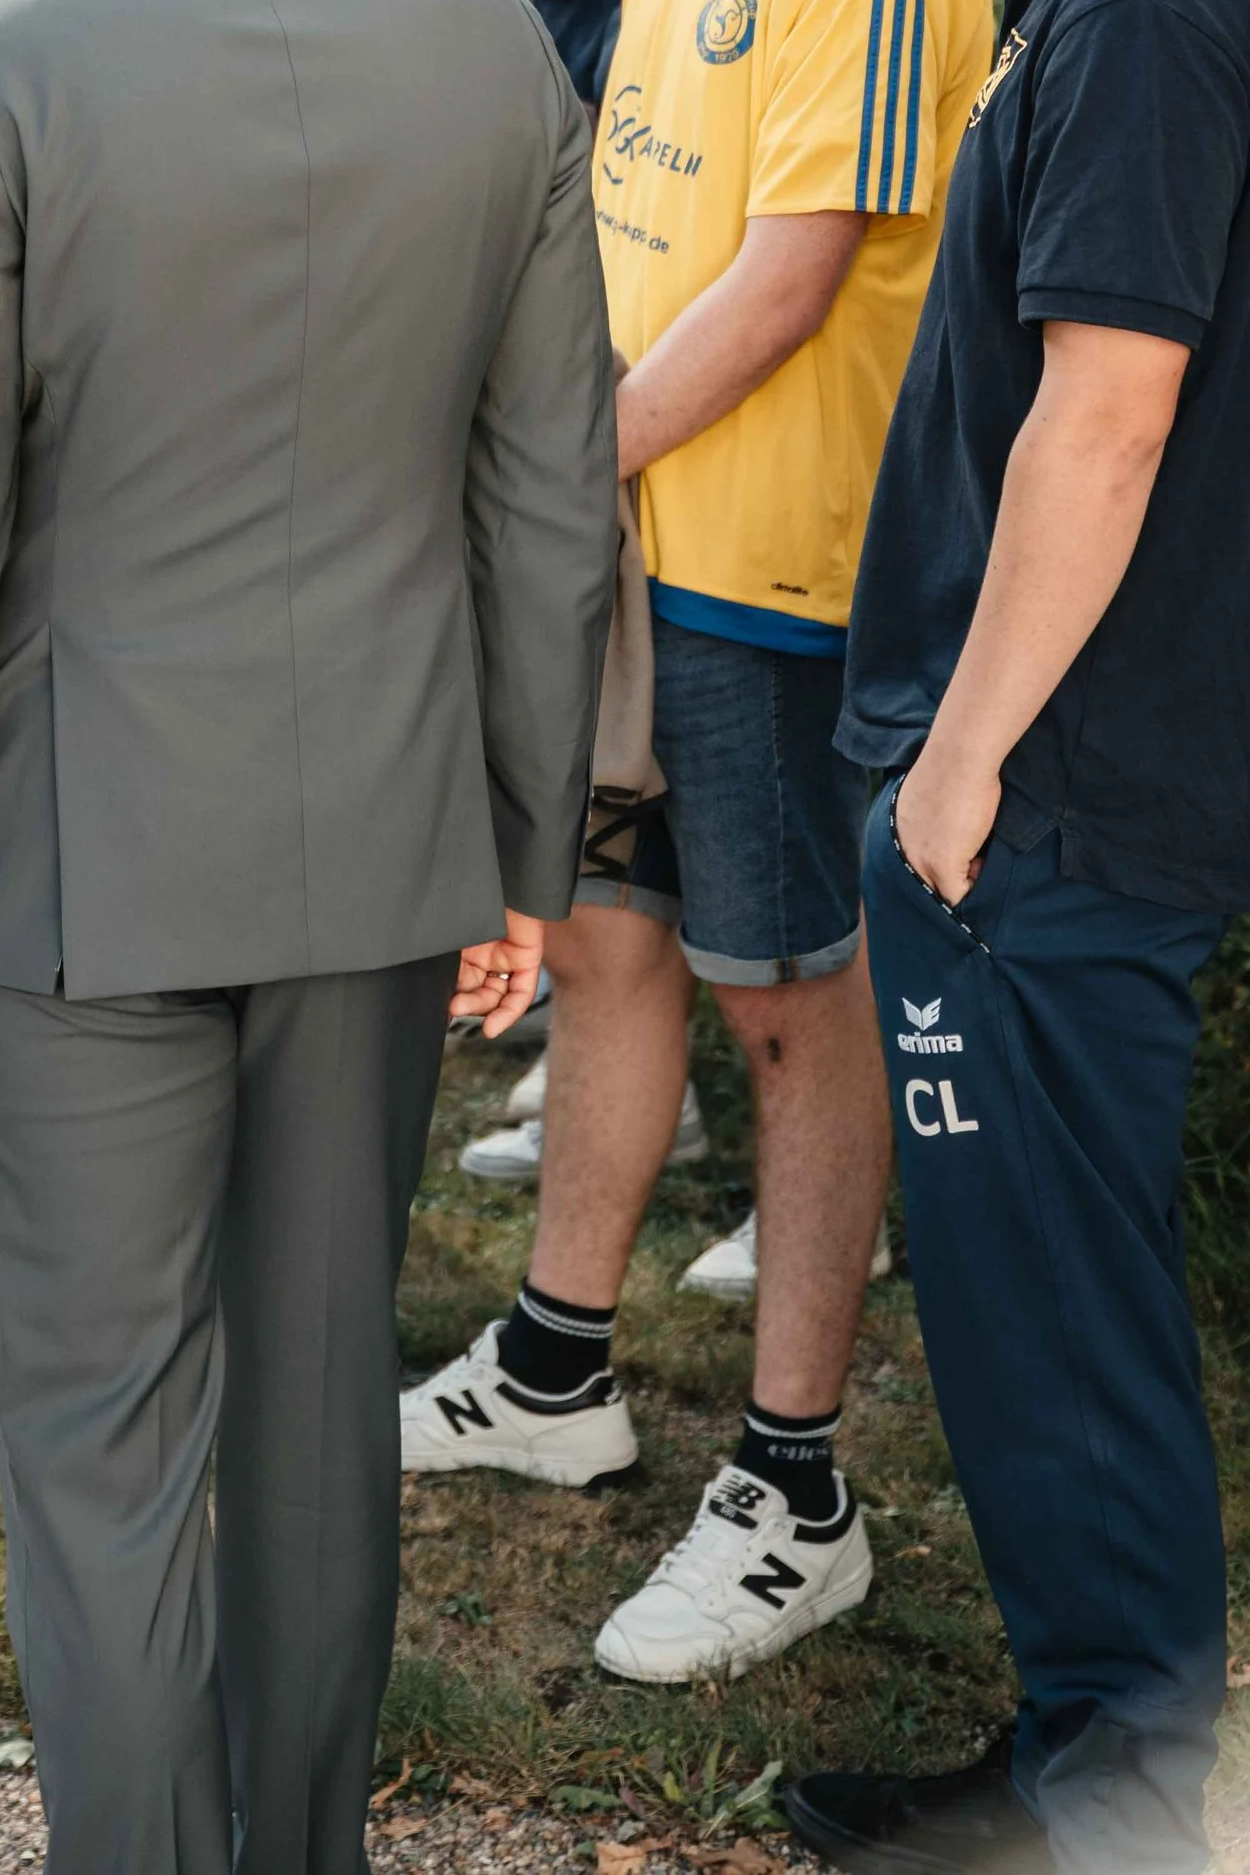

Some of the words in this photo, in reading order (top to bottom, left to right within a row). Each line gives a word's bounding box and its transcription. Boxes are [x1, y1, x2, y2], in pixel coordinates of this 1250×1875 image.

[897, 1031, 964, 1054] erima
[905, 1078, 980, 1137] CL
[433, 1388, 495, 1437] N
[738, 1551, 808, 1611] N
